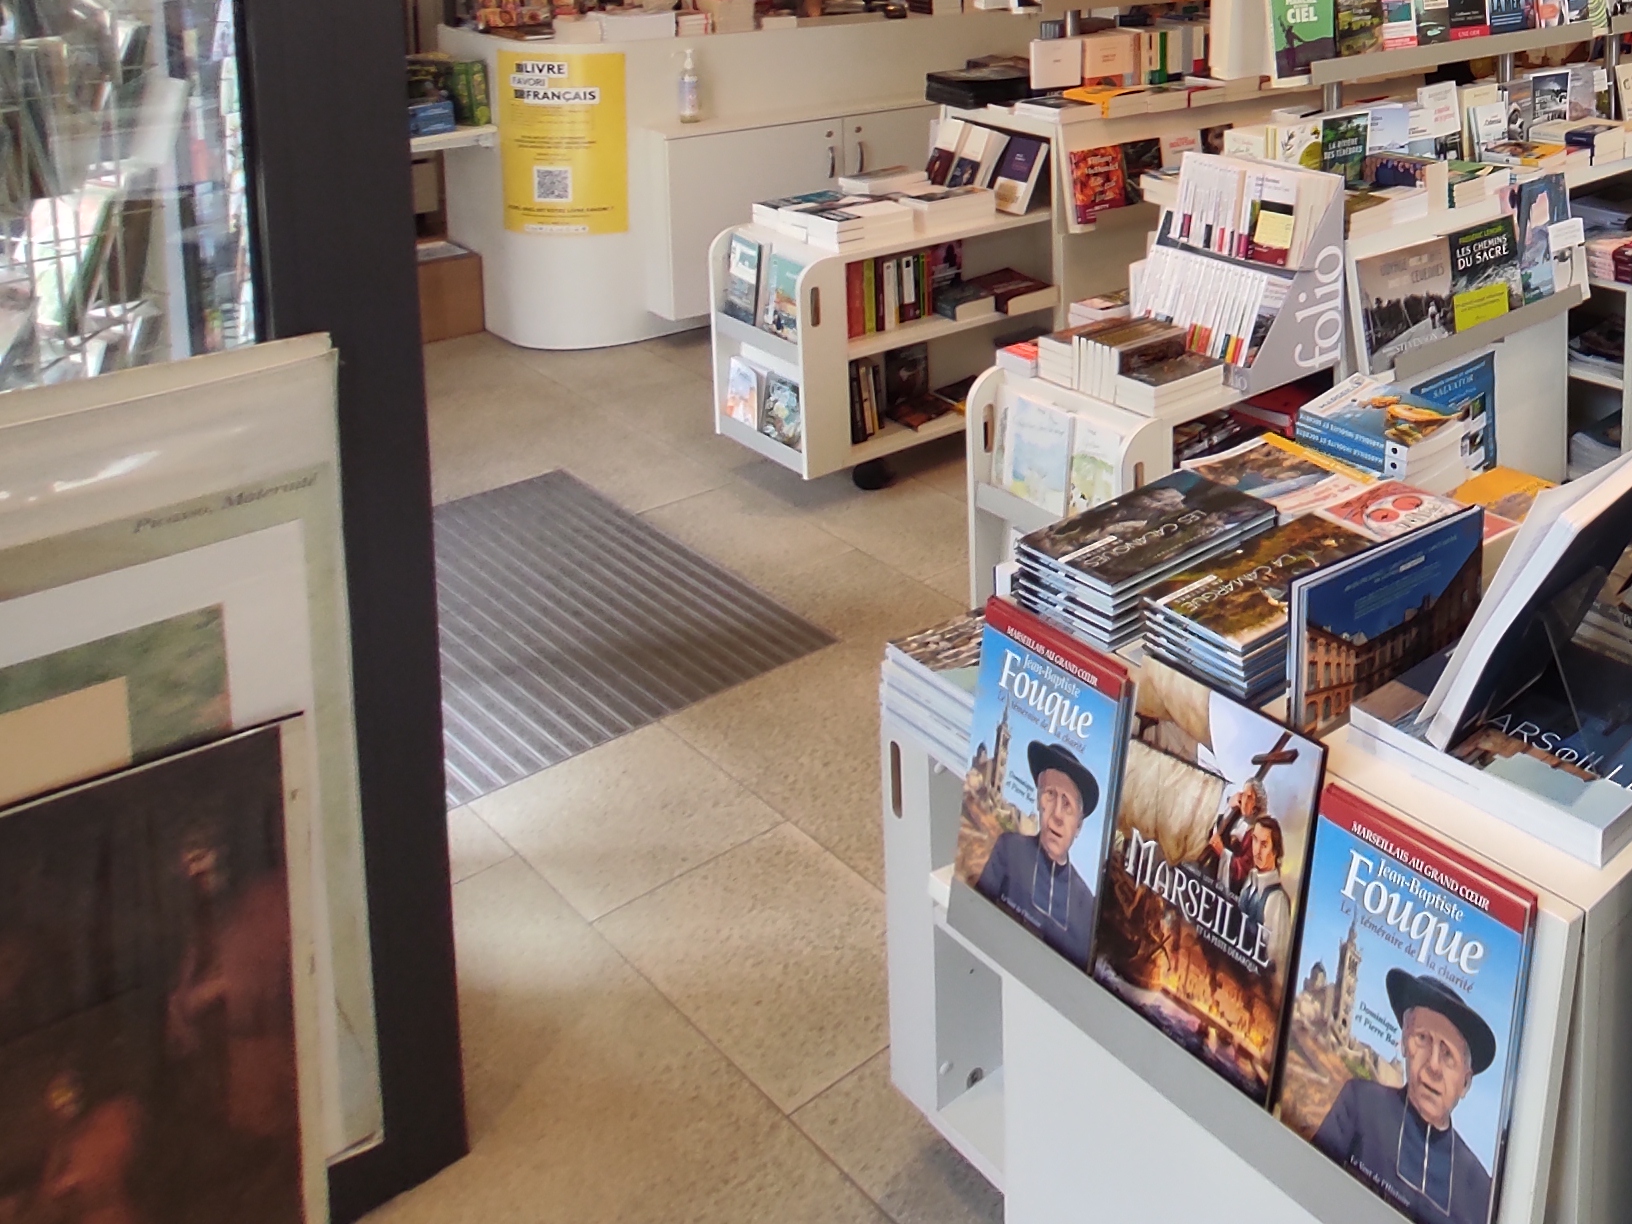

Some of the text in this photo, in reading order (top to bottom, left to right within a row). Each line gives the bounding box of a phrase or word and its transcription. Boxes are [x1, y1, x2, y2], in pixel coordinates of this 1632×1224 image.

[1286, 6, 1318, 24] CIEL
[524, 62, 566, 75] LIVRE
[525, 89, 597, 104] FRANÇAIS
[1456, 233, 1508, 259] LES CHEMINS
[1457, 243, 1510, 271] DU SACRÉ
[1294, 244, 1344, 370] folio
[1006, 624, 1046, 656] MARSEILLAIS
[1054, 653, 1078, 677] GRAND
[998, 647, 1094, 741] Fouque
[1022, 653, 1082, 699] Jean-Baptiste
[1351, 820, 1491, 912] MARSEILLAIS AU GRAND CŒUR
[1377, 856, 1465, 923] Jean-Baptiste
[1124, 826, 1274, 969] MARSEILLE
[1340, 848, 1486, 976] Fouque
[1358, 914, 1405, 953] téméraire
[1403, 941, 1417, 958] de
[1437, 962, 1475, 995] charité
[1358, 1000, 1400, 1034] Dominique
[1363, 1016, 1387, 1041] Pierre
